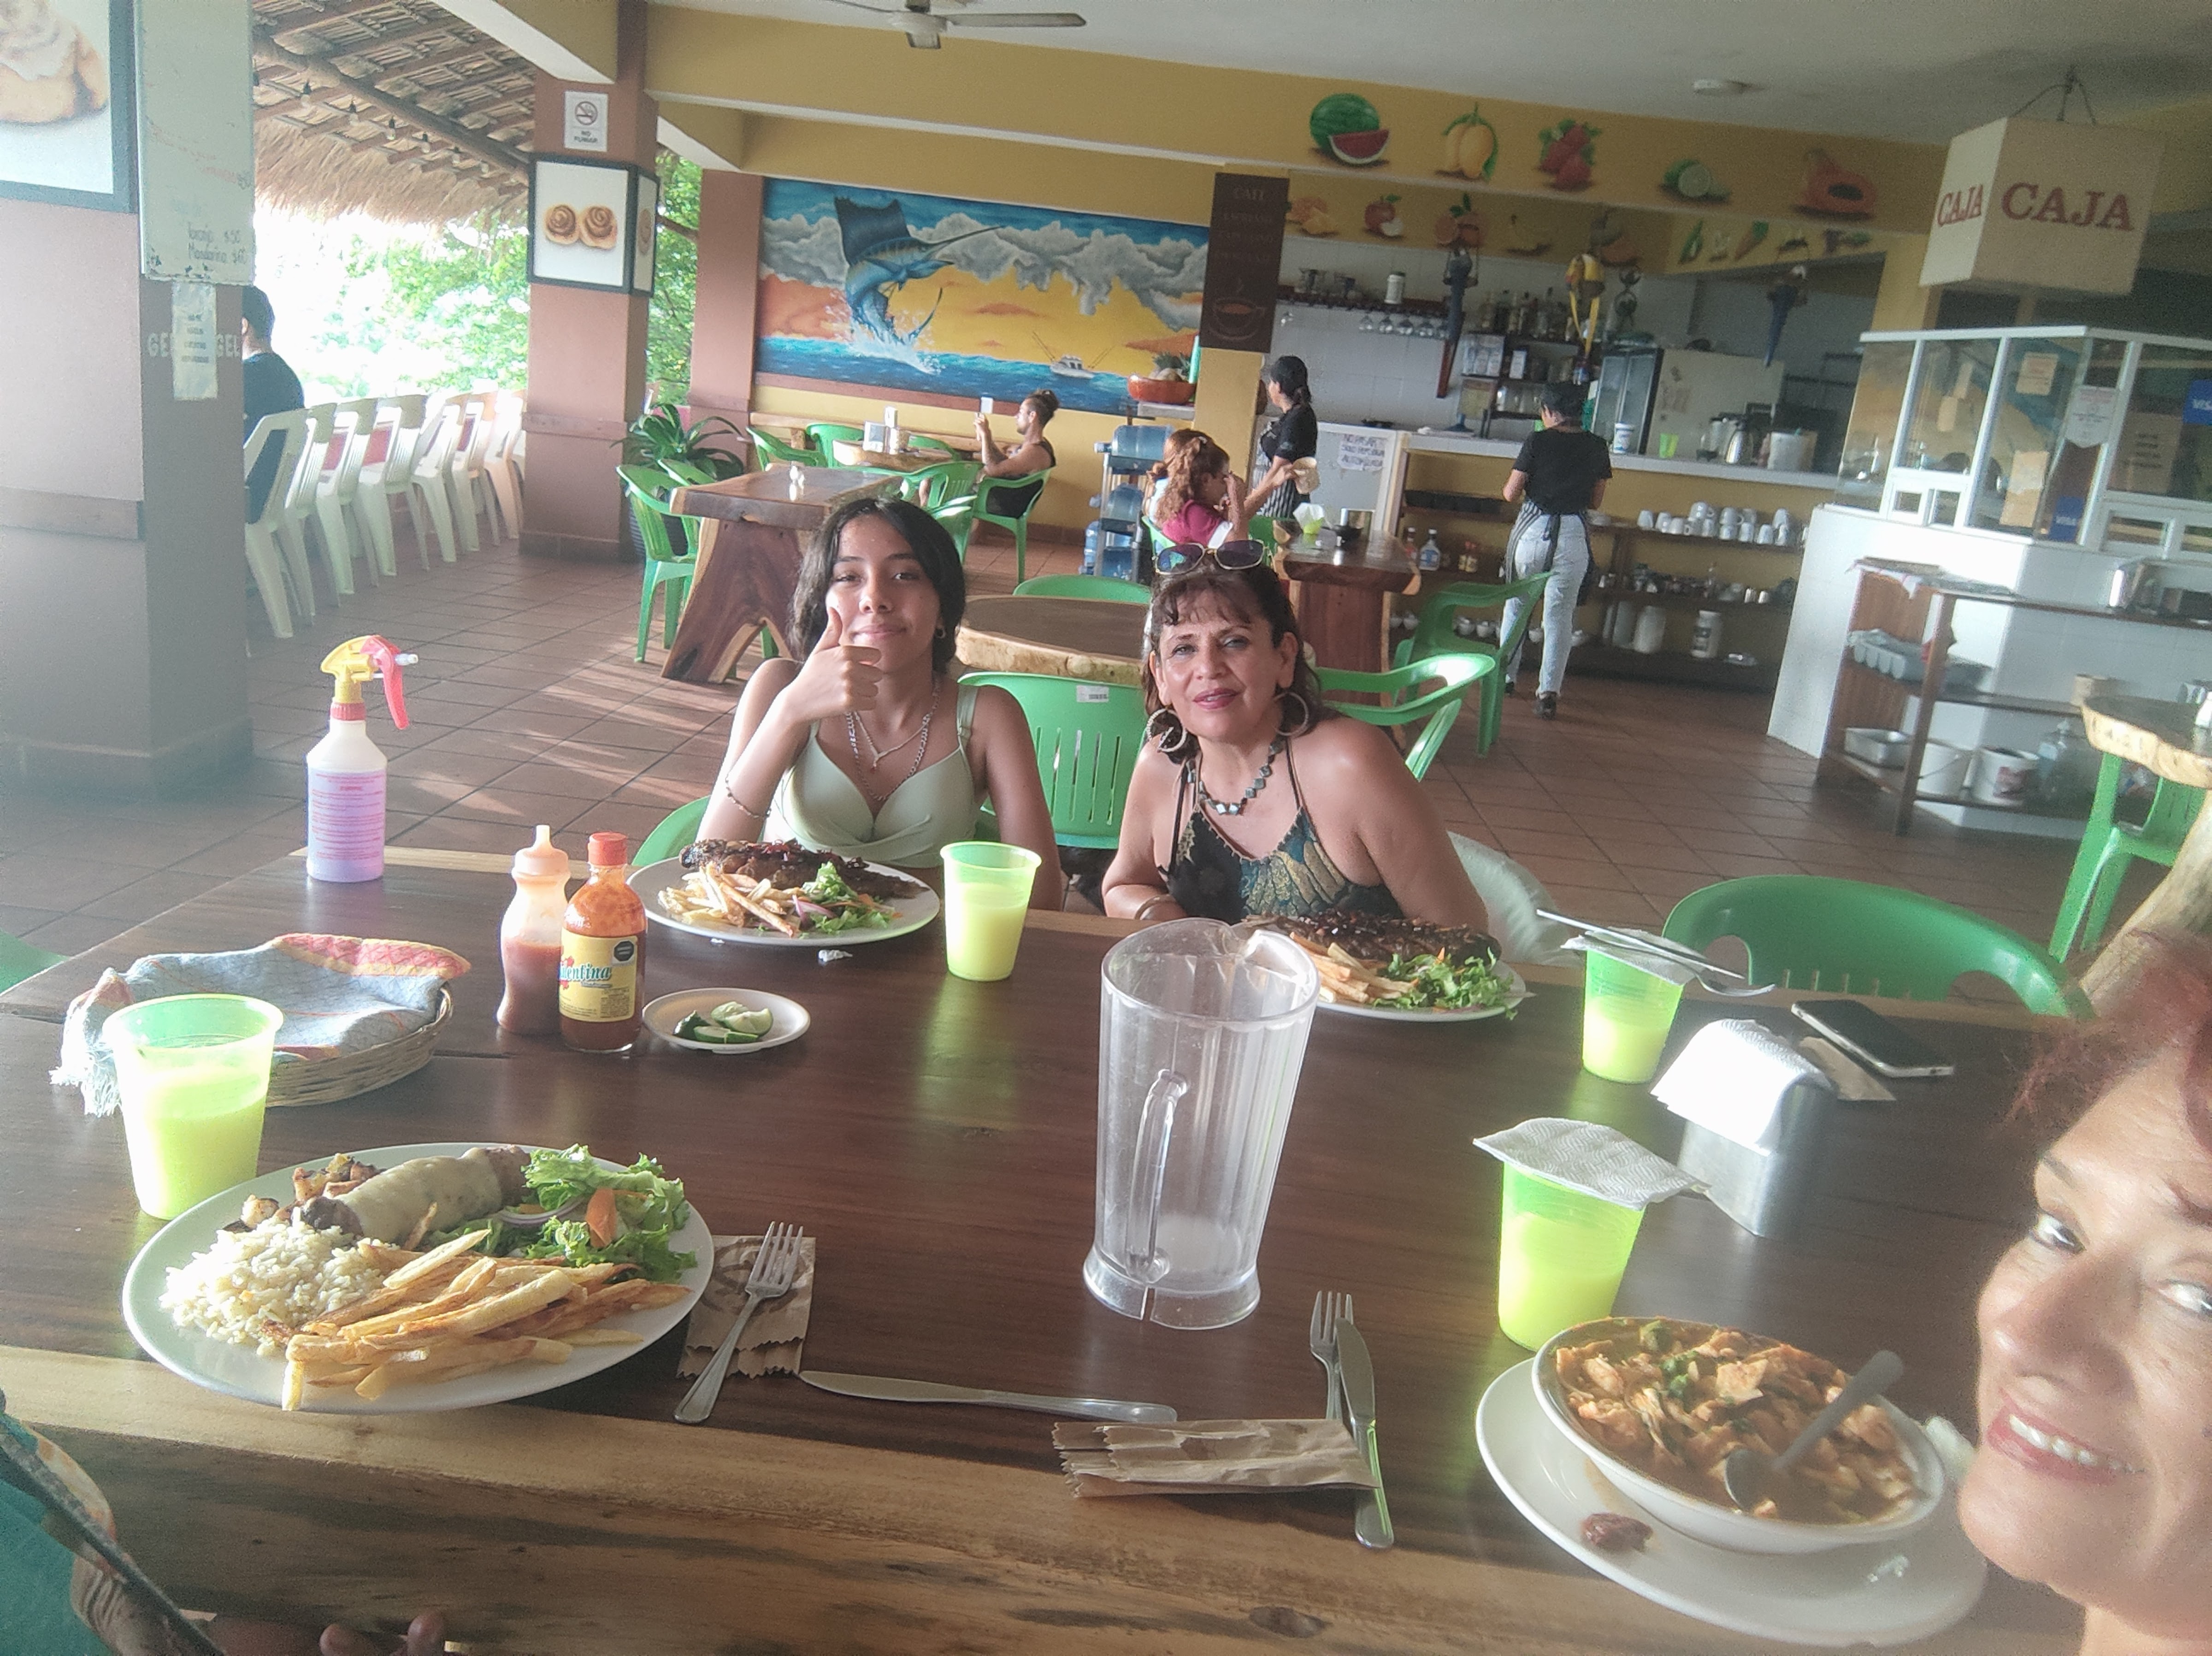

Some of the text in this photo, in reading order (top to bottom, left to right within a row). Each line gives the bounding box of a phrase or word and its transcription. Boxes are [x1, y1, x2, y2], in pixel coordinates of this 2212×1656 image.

[1937, 183, 1984, 227] CAJA
[2001, 182, 2135, 232] CAJA
[147, 332, 172, 357] GE
